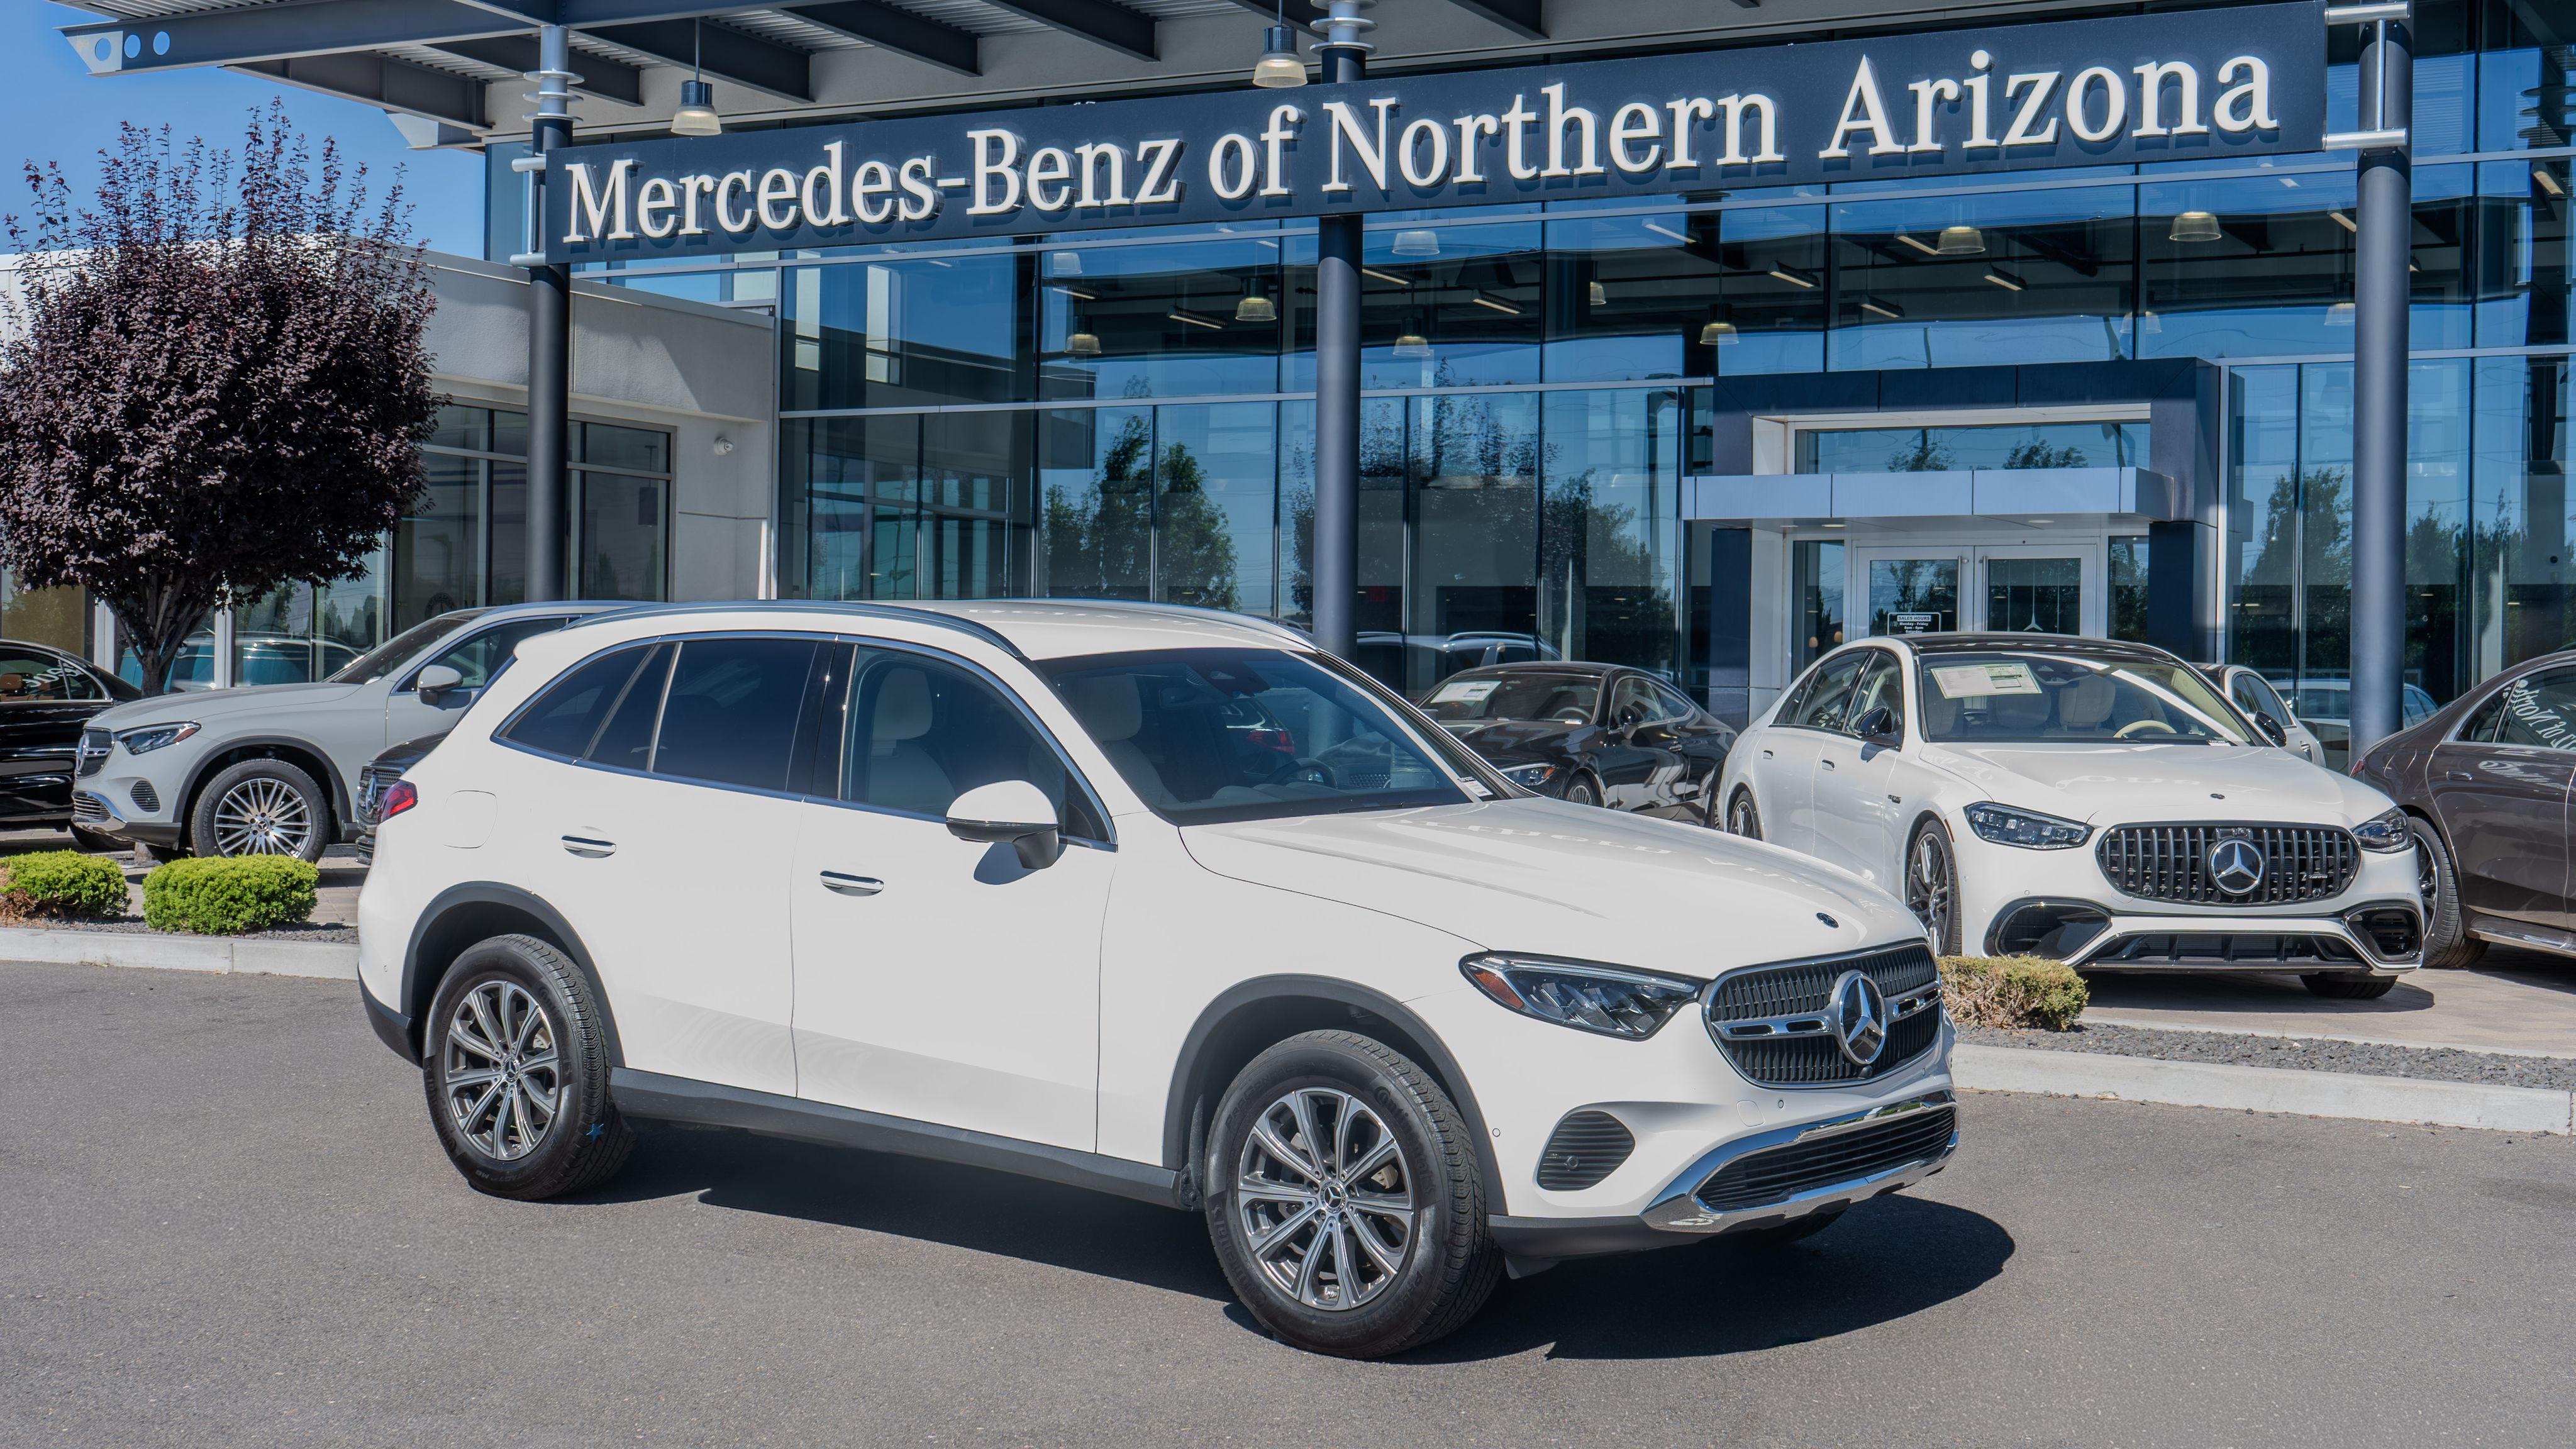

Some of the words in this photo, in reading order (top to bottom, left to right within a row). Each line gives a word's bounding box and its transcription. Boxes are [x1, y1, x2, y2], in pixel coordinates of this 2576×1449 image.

[563, 129, 1180, 243] Mercedes-Benz
[1208, 104, 1301, 199] of
[1322, 82, 1788, 192] Northern
[1818, 50, 2280, 160] Arizona
